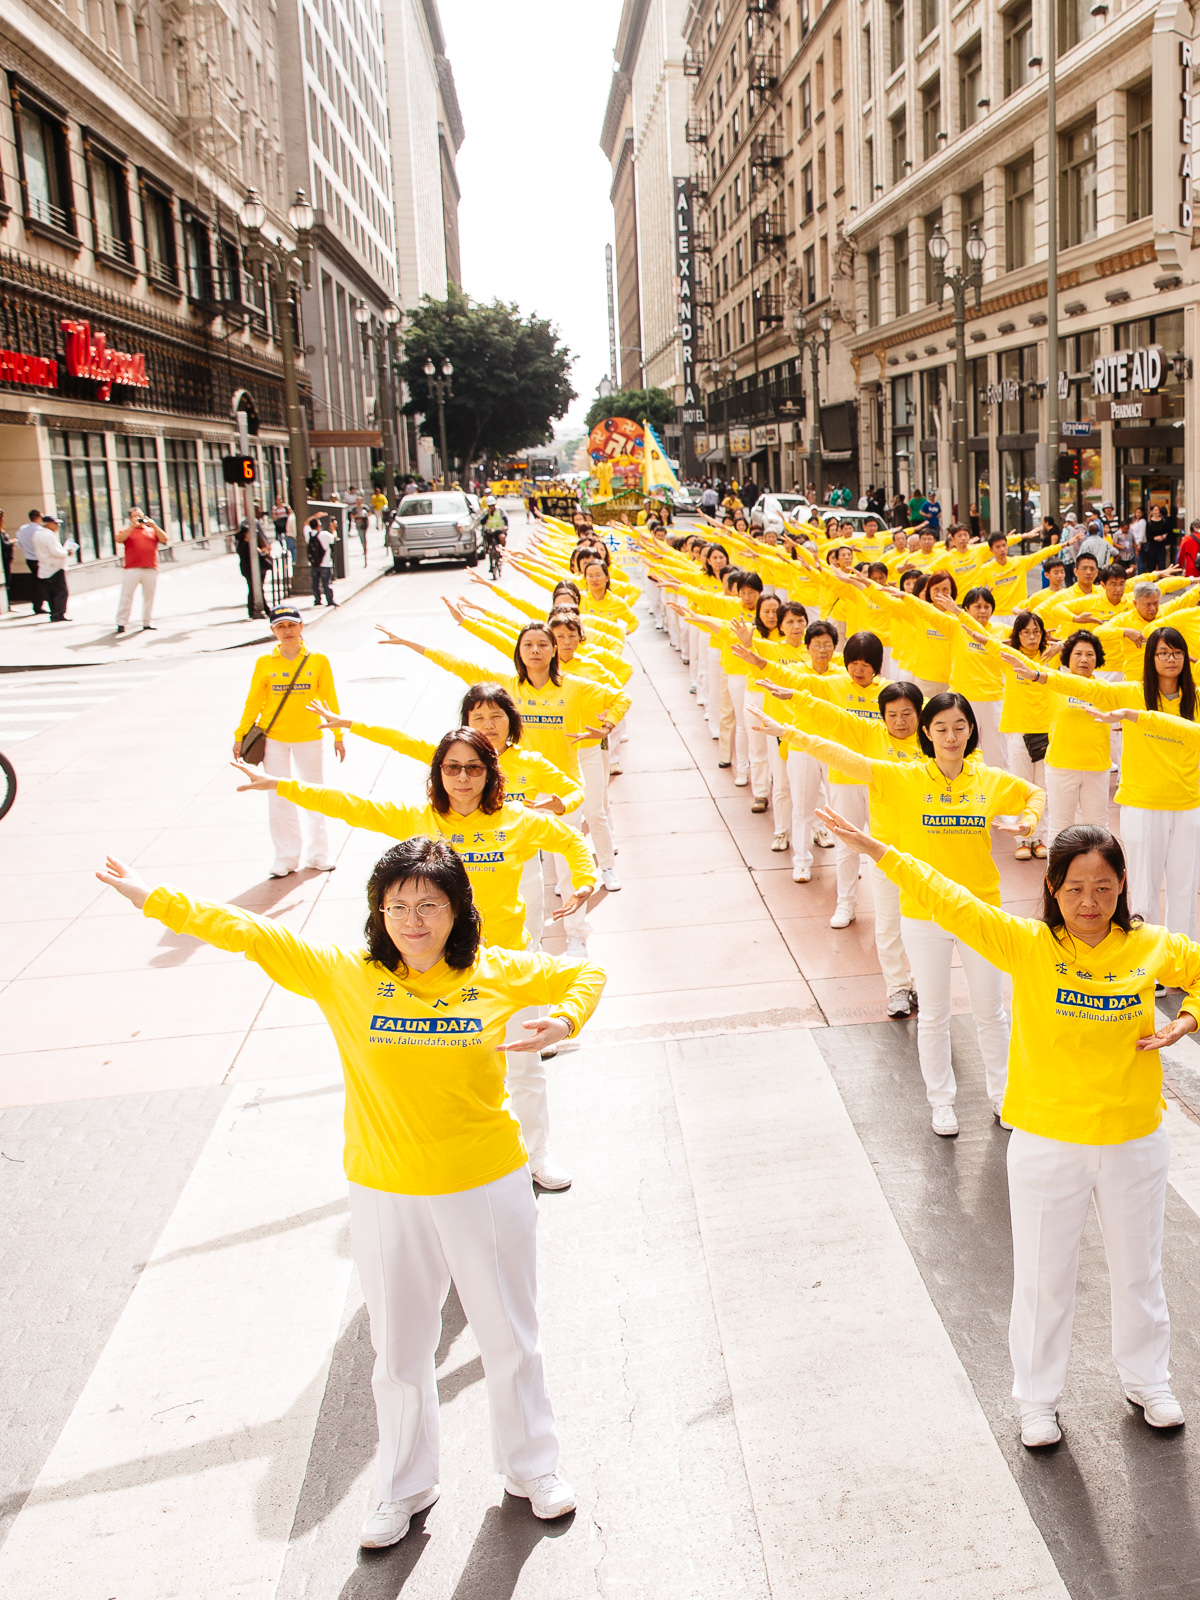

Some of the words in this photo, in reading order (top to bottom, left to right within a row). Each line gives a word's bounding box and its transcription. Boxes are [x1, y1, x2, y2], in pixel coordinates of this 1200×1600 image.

[1180, 41, 1192, 144] RITE
[1180, 154, 1192, 228] AID
[677, 193, 695, 403] ALEXANDRIA
[1094, 353, 1128, 395] RITE
[1131, 350, 1161, 390] AID
[682, 409, 705, 423] HOTEL
[1110, 402, 1142, 419] PHARMACY
[1062, 422, 1090, 432] Broadway
[244, 462, 253, 479] 6
[923, 793, 986, 804] 法輪大法
[924, 816, 956, 826] FALUN
[960, 816, 984, 827] DAFA
[473, 852, 502, 862] DAFA
[1060, 991, 1103, 1009] FALUN
[1055, 1008, 1143, 1022] www.falundafa.org.tw
[375, 1018, 430, 1032] FALUN
[436, 1020, 479, 1032] DAFA
[369, 1036, 483, 1048] www.falundafa.org.tw
